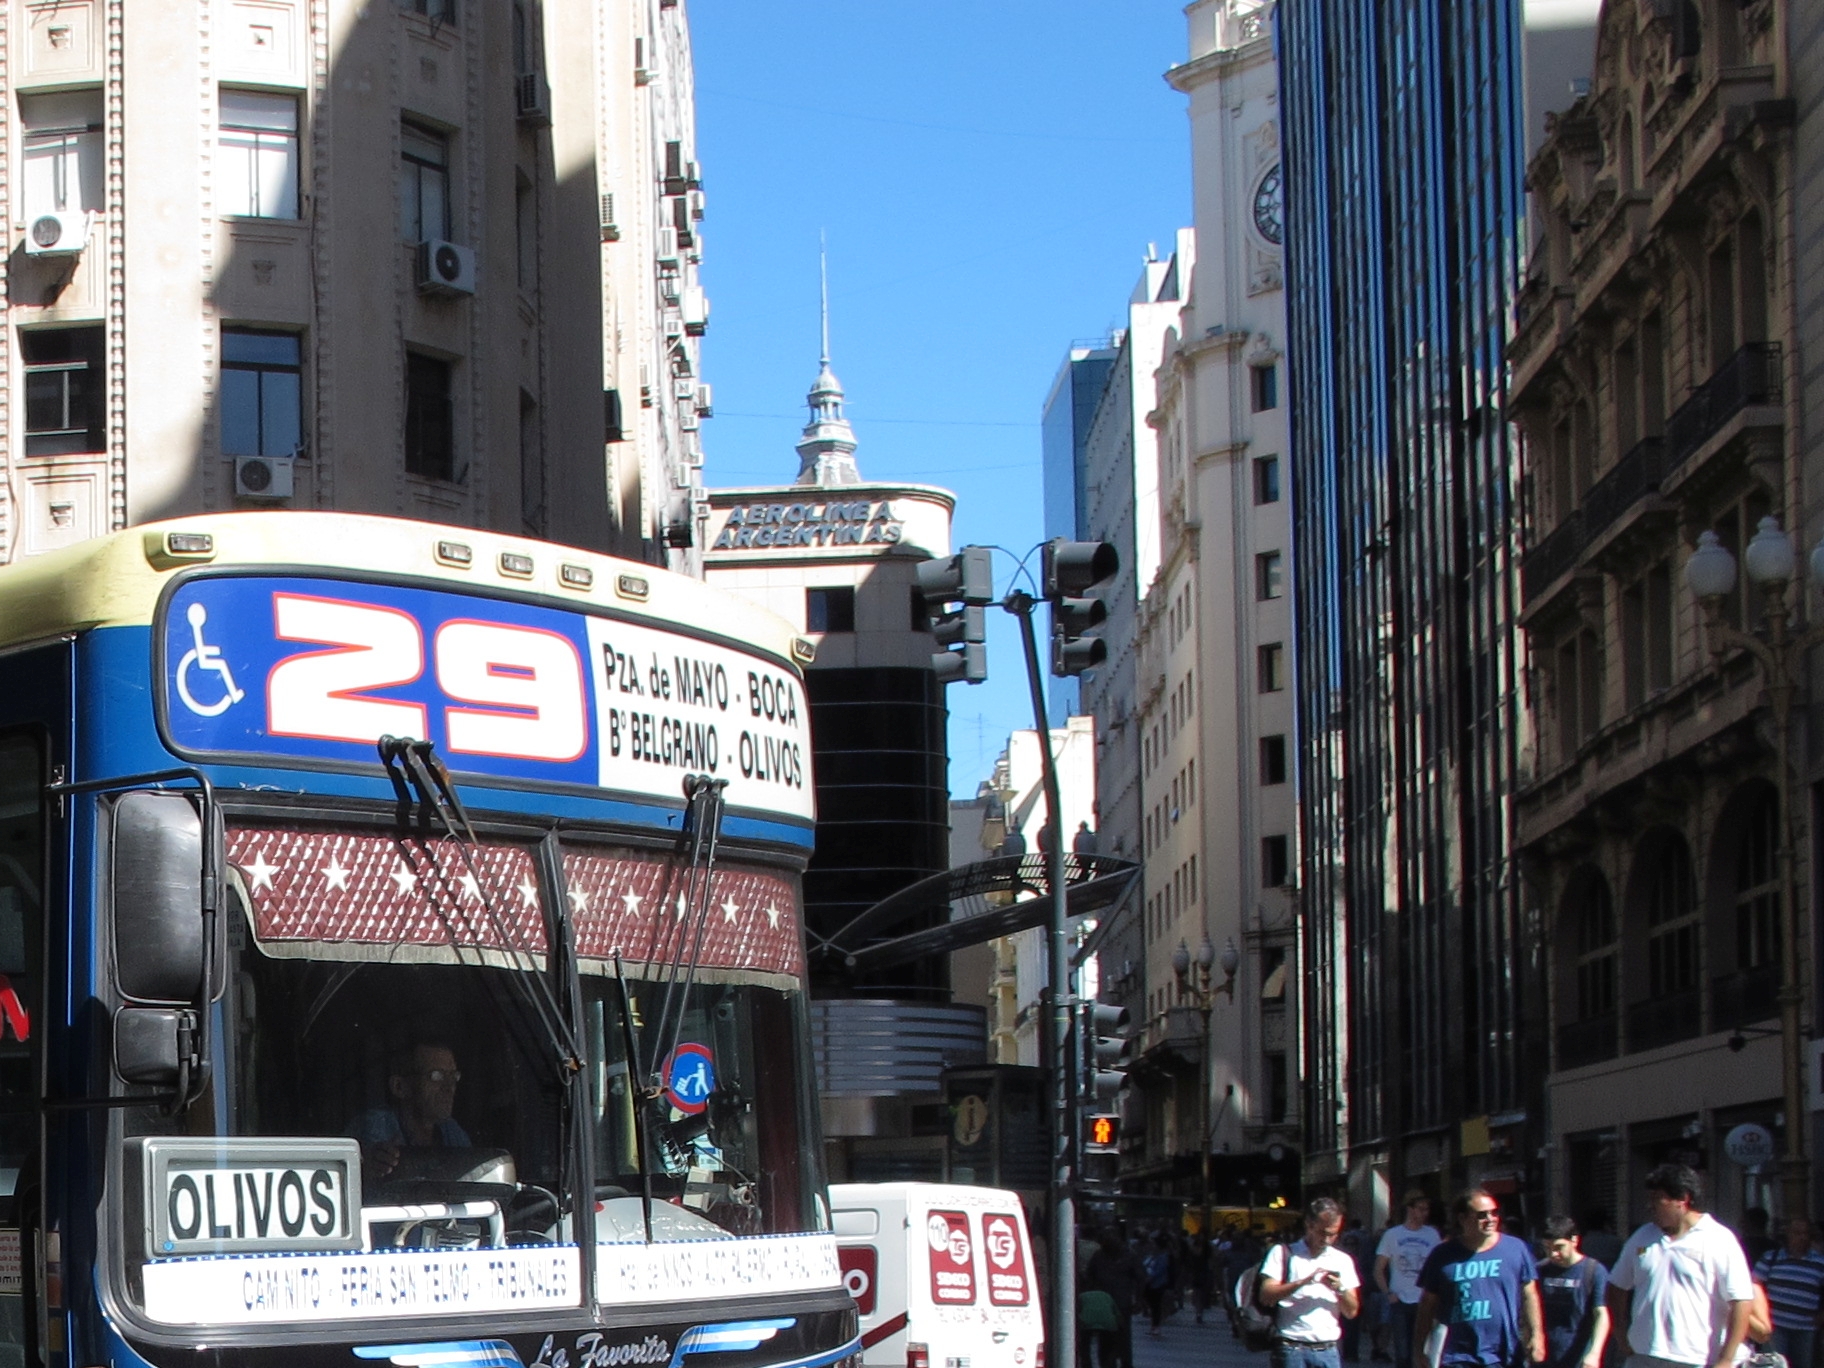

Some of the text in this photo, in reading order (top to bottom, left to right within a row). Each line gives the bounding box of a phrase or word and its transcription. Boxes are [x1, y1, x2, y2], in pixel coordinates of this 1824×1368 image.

[713, 521, 903, 548] ARGENTINAS
[727, 501, 904, 525] AEROLINEA
[267, 592, 588, 762] 29
[650, 652, 670, 700] de
[674, 656, 728, 711] MAYO
[748, 671, 798, 728] BOCA
[631, 711, 718, 773] BELGRANO
[739, 730, 802, 789] OLIVOS
[169, 1169, 336, 1239] OLIVOS
[244, 1258, 567, 1311] CAMINITO FERIA SAN TELMO TRIBUNALES
[1454, 1259, 1502, 1281] LOVE
